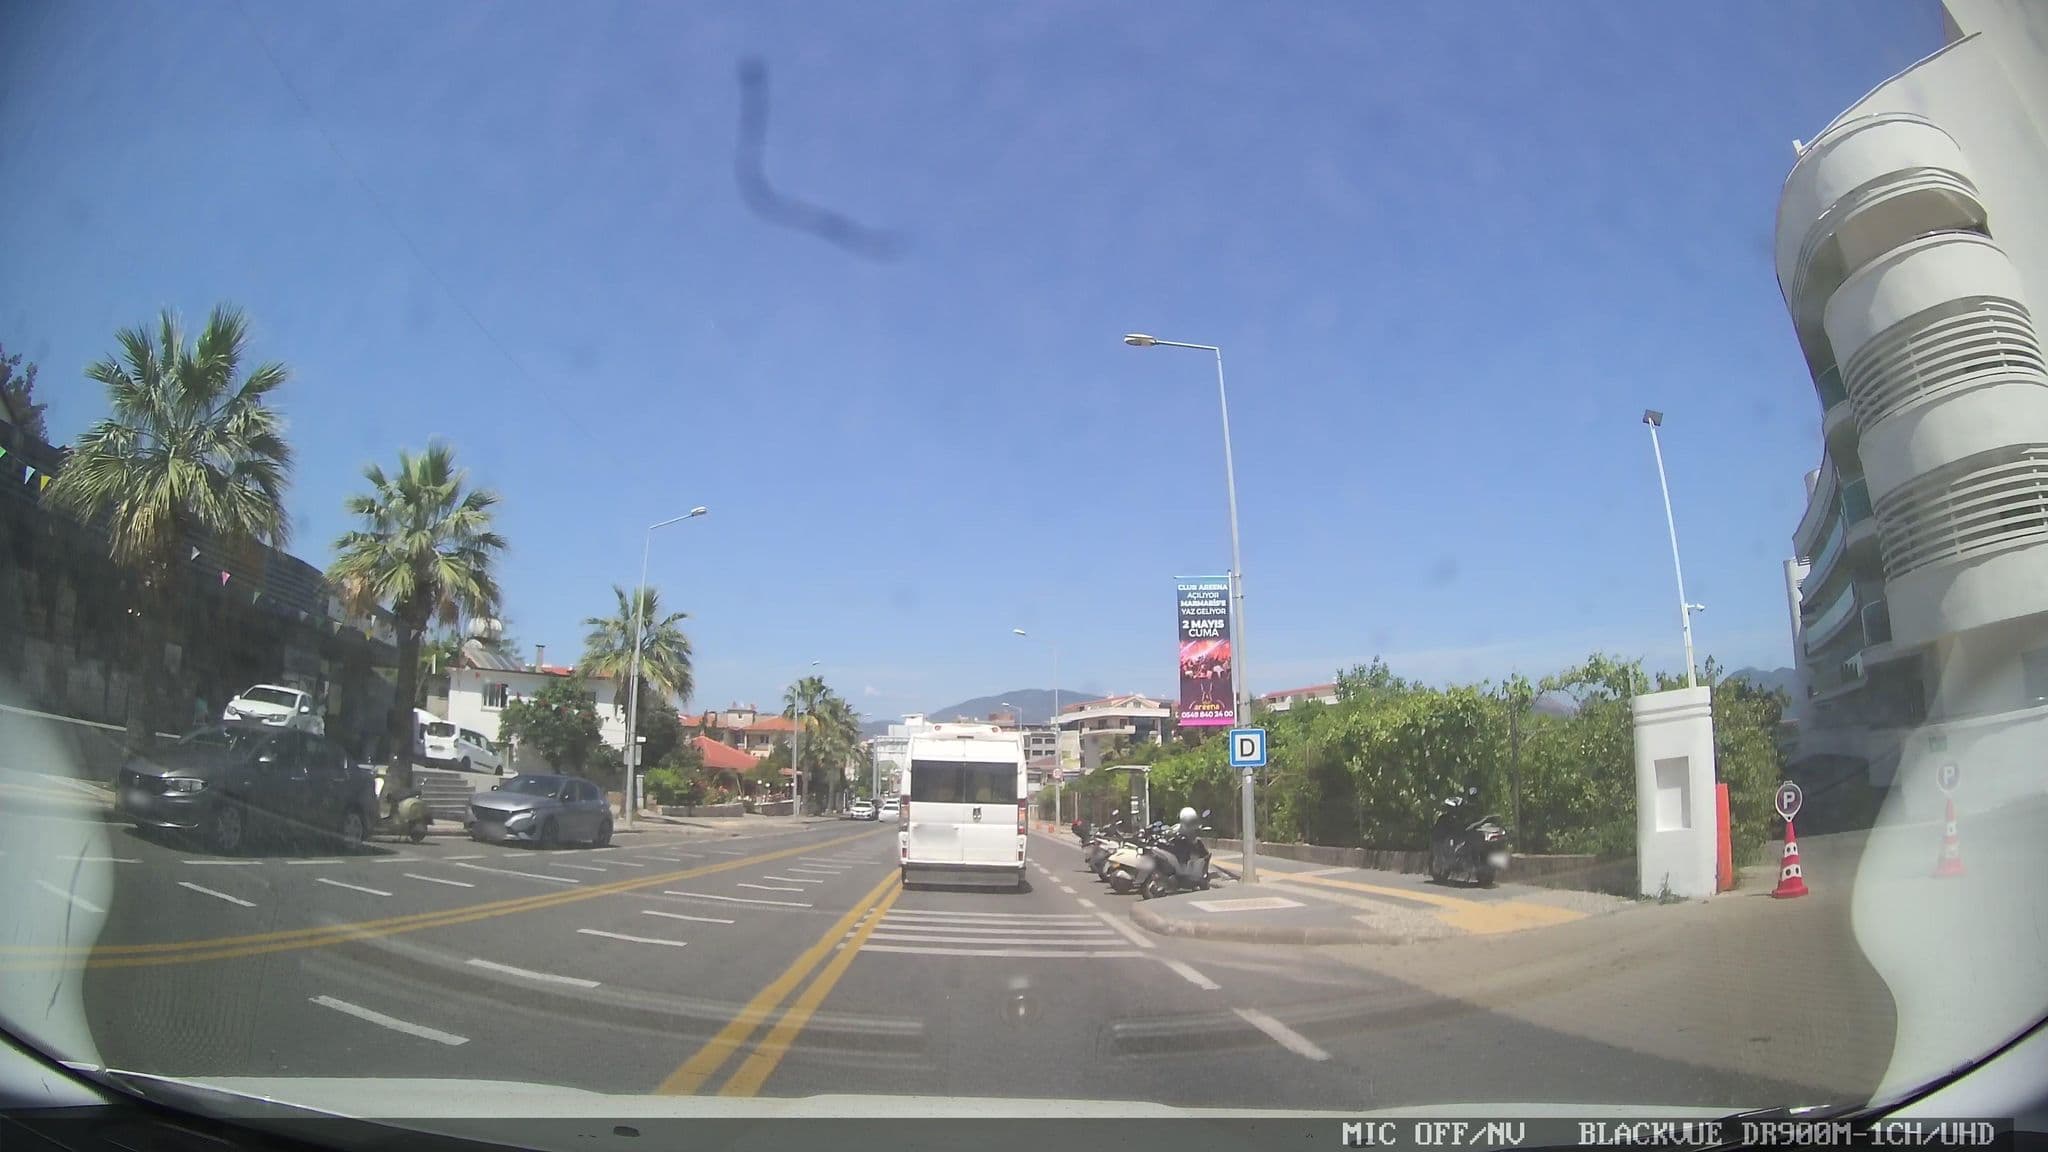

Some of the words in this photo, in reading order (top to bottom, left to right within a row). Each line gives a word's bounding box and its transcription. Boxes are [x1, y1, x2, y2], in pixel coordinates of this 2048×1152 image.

[1182, 620, 1190, 629] 2
[1191, 620, 1224, 628] MAYIS
[1188, 629, 1219, 637] CUMA
[1240, 738, 1255, 757] D
[1783, 791, 1796, 809] P
